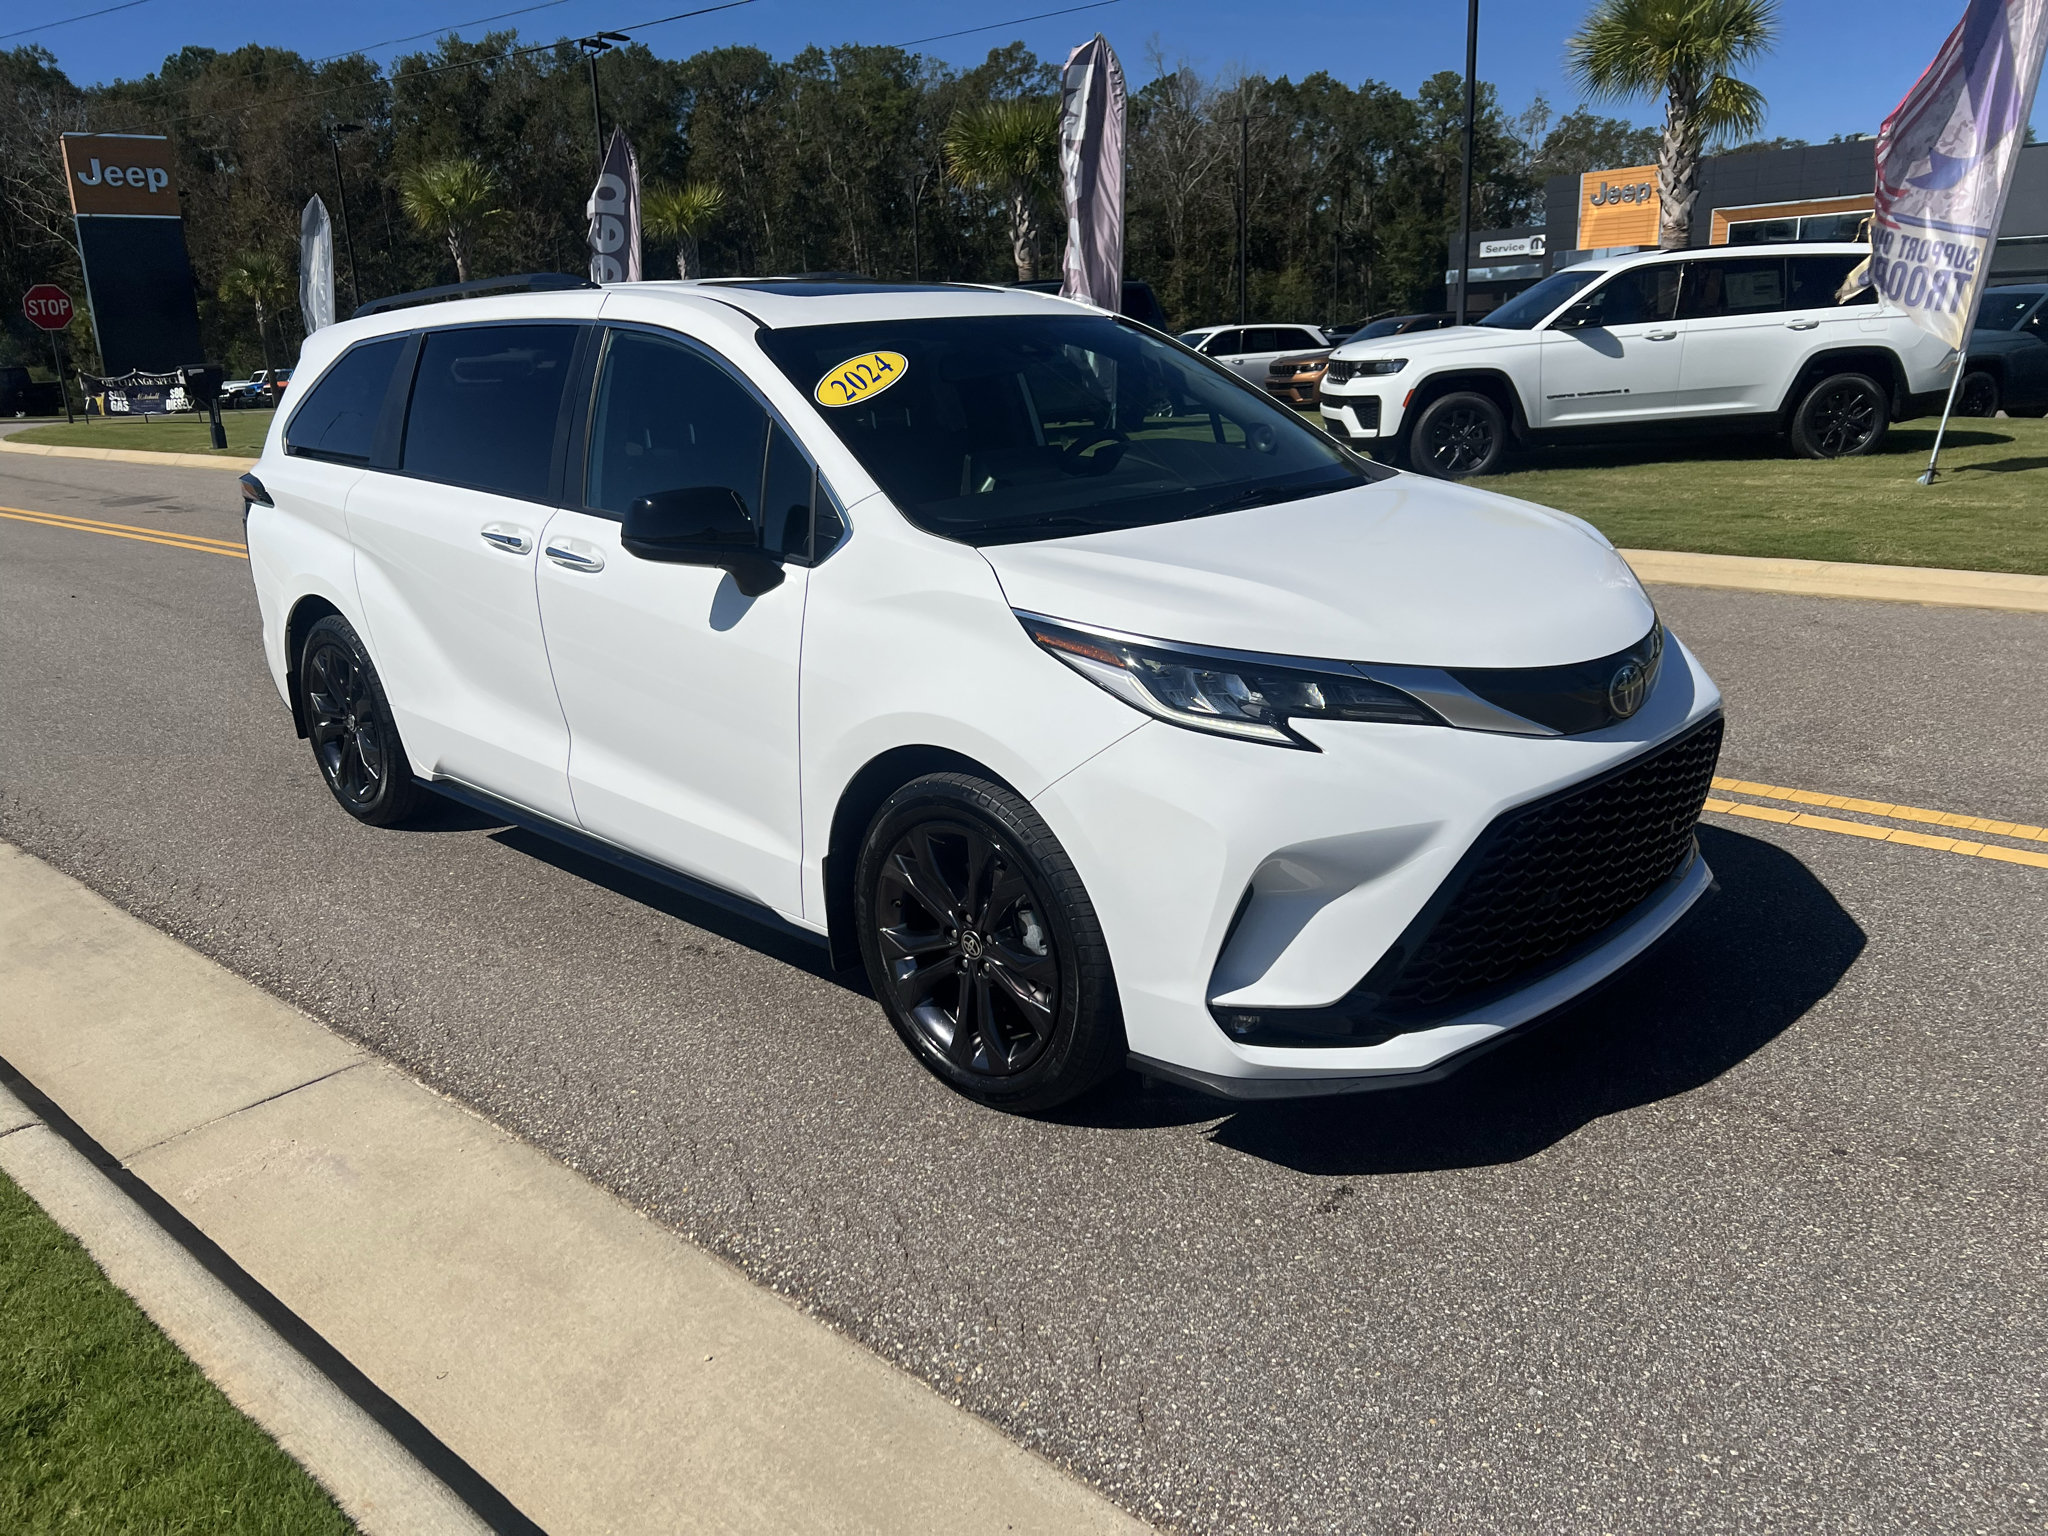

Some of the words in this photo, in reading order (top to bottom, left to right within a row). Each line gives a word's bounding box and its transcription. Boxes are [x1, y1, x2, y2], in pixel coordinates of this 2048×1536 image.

[77, 158, 169, 193] Jeep
[1590, 181, 1652, 206] Jeep
[1485, 243, 1526, 254] Service
[28, 299, 69, 316] STOP
[153, 376, 180, 386] SPECI
[830, 354, 894, 402] 2024
[110, 400, 130, 412] GAS
